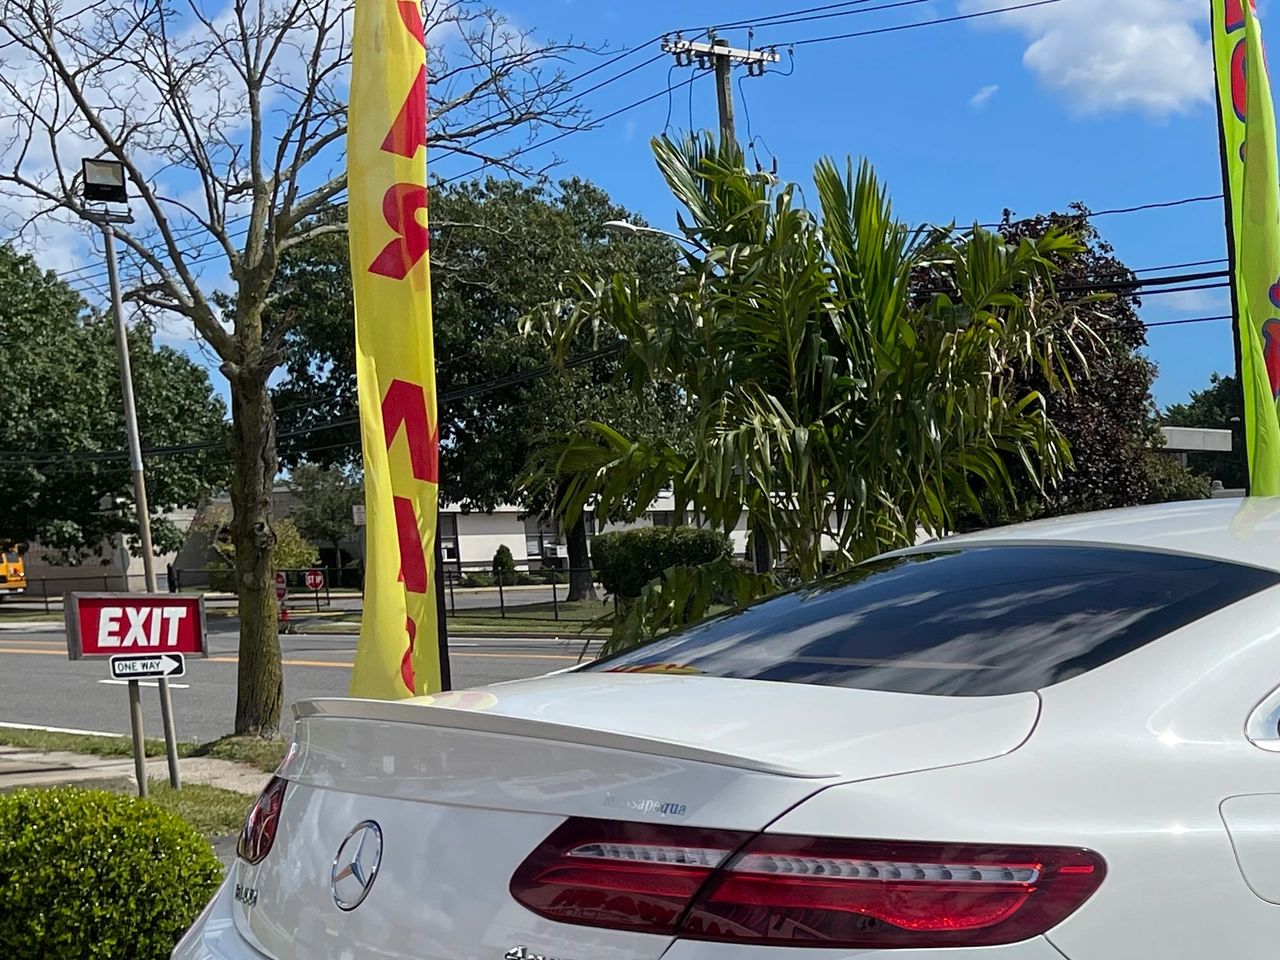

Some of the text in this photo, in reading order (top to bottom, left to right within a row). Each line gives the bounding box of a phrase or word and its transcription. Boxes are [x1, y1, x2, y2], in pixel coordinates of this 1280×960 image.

[97, 606, 187, 647] EXIT
[117, 661, 161, 671] ONE WAY
